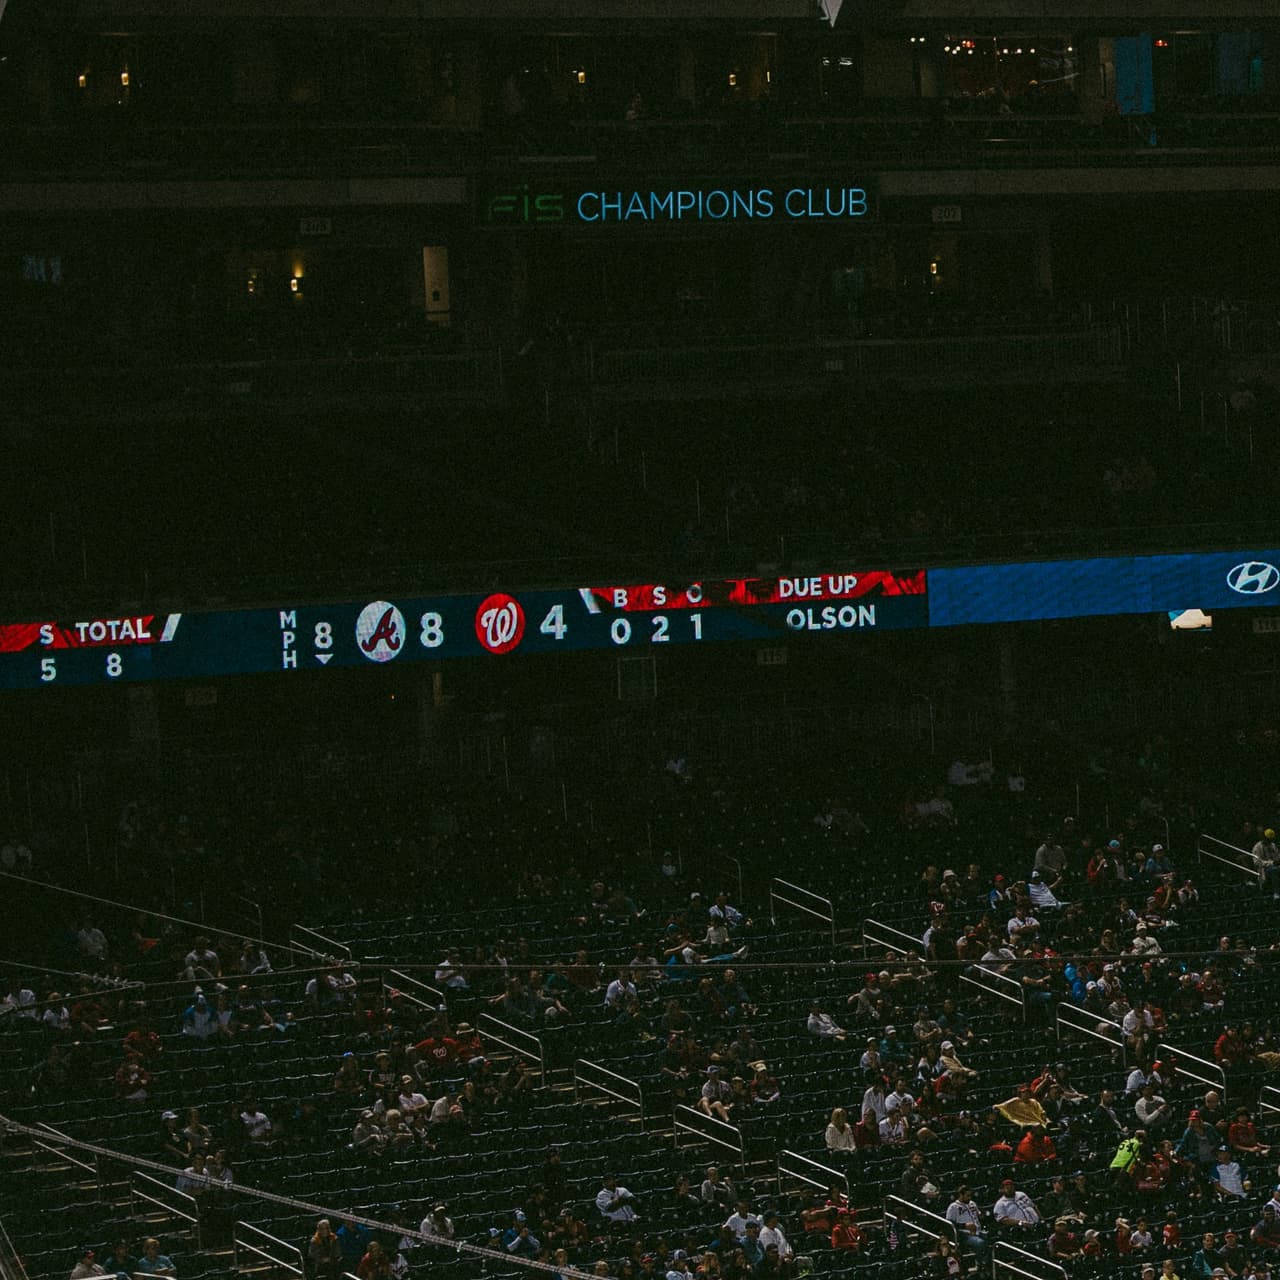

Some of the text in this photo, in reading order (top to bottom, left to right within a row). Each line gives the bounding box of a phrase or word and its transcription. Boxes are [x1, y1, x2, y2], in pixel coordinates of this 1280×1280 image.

[577, 189, 774, 222] CHAMPIONS
[784, 188, 868, 217] CLUB
[613, 583, 703, 608] B S O
[779, 575, 858, 598] DUE UP
[420, 612, 444, 648] 8
[539, 604, 568, 640] 4
[610, 613, 703, 645] 0 2 1
[786, 604, 877, 631] OLSON
[39, 619, 152, 645] S TOTAL
[314, 622, 334, 649] 8
[40, 653, 123, 681] 5 8
